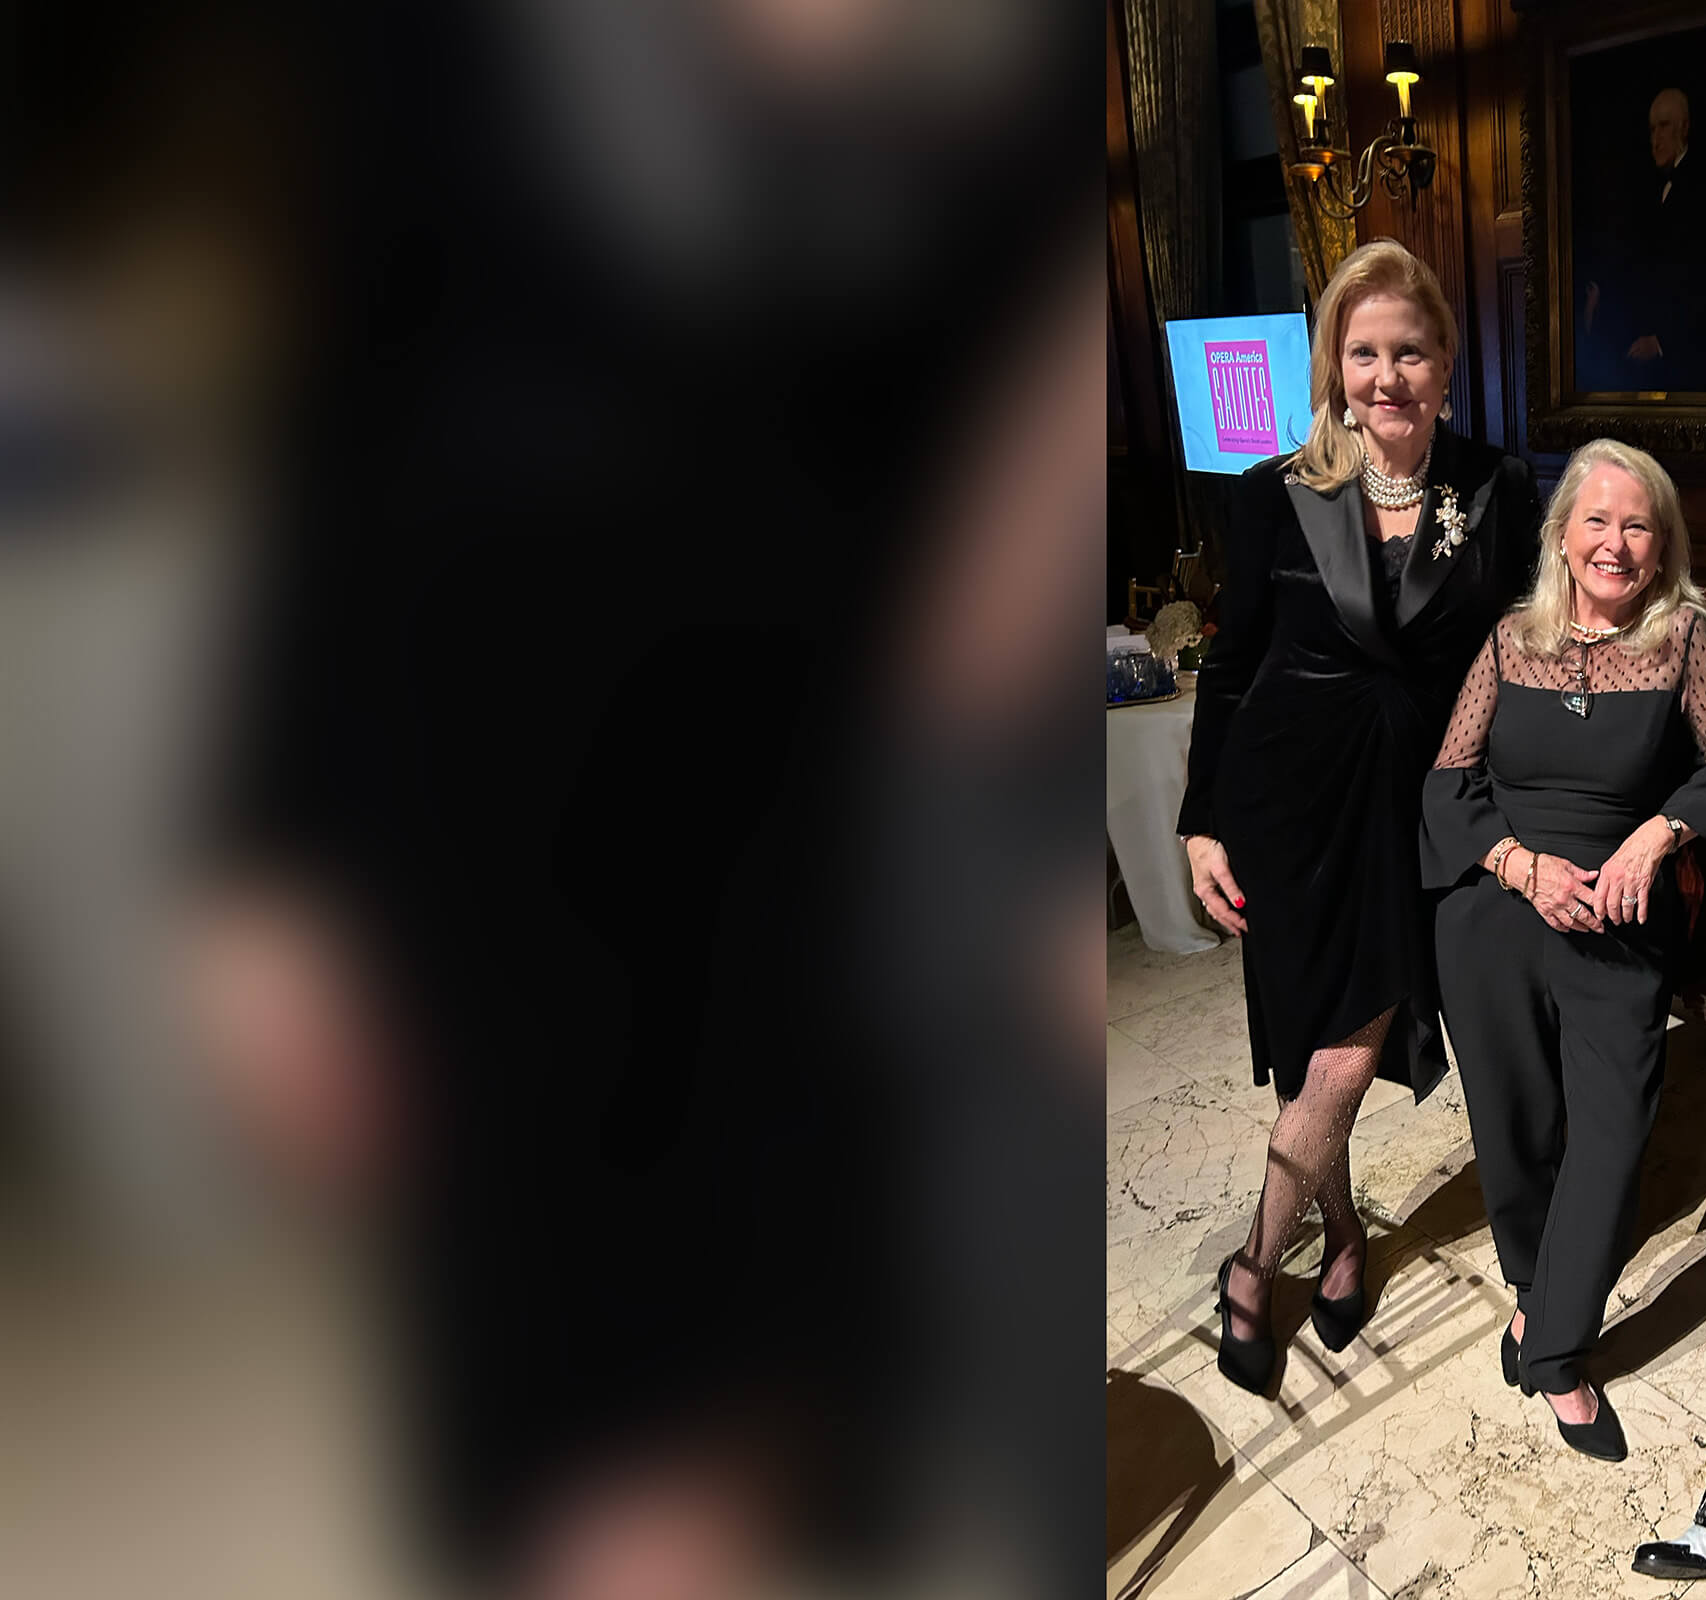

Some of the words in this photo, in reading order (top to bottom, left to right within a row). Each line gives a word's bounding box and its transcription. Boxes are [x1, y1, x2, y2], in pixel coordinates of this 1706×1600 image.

[1211, 351, 1235, 364] OPERA
[1236, 350, 1264, 364] America
[1212, 367, 1272, 432] SALUTES
